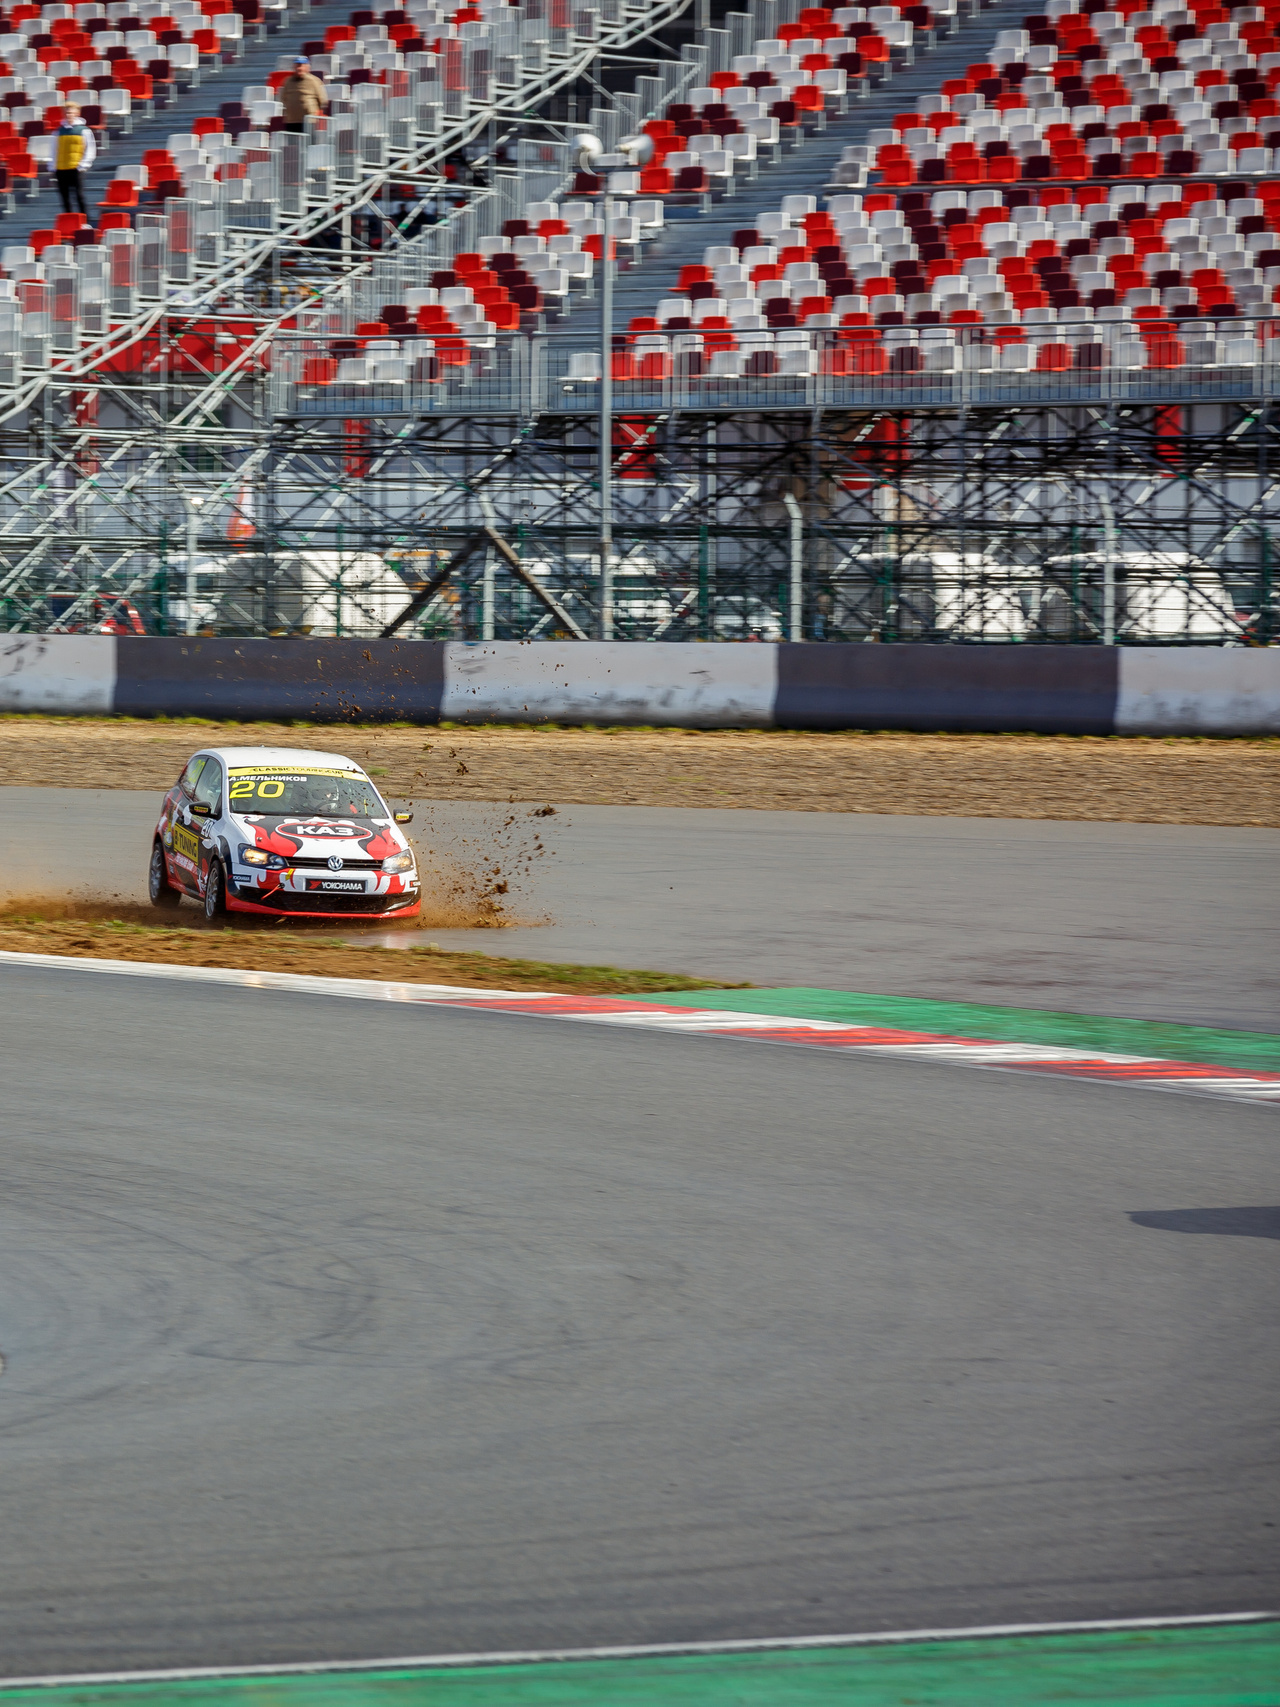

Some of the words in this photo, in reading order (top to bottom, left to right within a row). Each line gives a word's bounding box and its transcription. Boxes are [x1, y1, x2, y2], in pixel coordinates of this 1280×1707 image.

[229, 780, 285, 799] 20
[296, 825, 354, 836] КАЗ
[321, 881, 362, 890] YOKOHAMA
